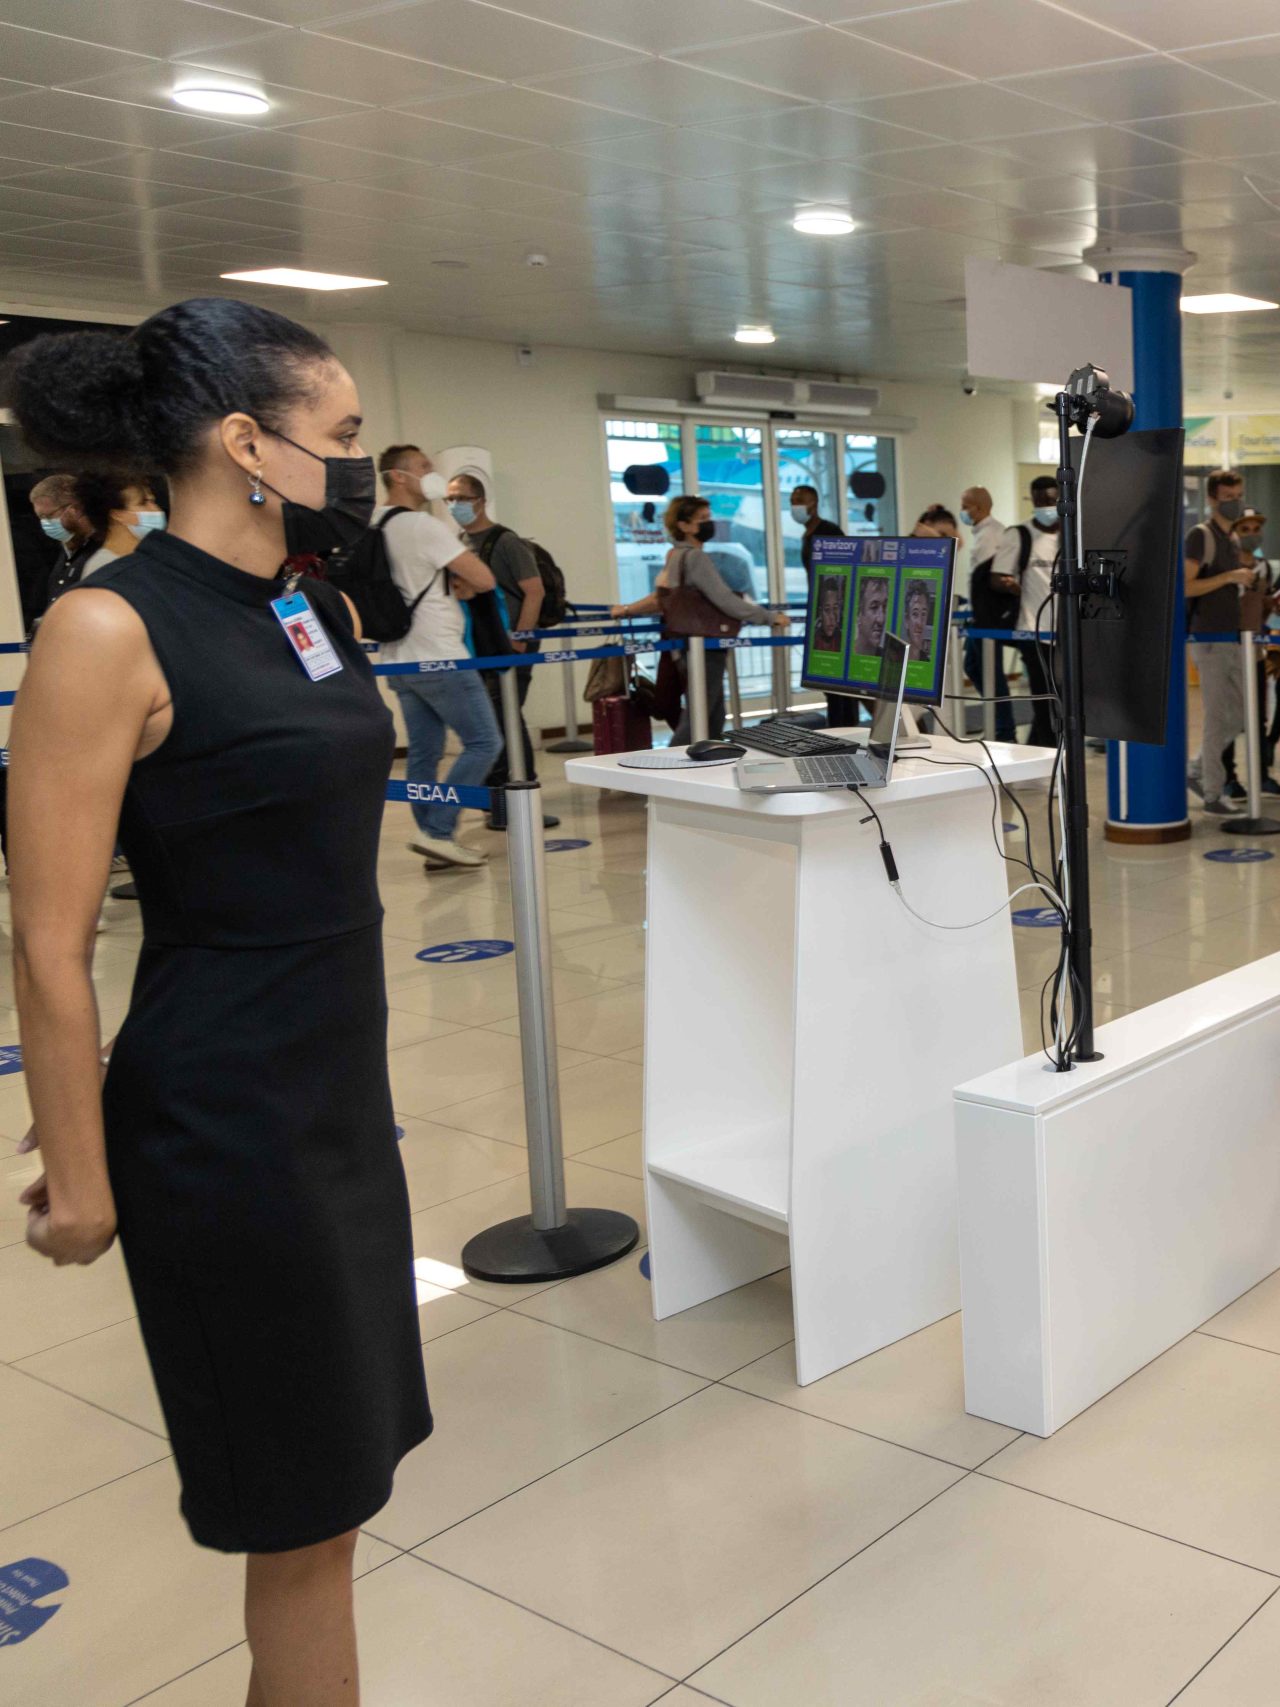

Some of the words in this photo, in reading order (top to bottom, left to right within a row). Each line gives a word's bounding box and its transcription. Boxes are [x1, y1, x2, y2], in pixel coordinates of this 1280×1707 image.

[823, 539, 858, 552] travizory
[624, 642, 655, 655] SCAA
[719, 638, 752, 649] SCAA
[544, 651, 578, 663] SCAA
[419, 660, 458, 673] SCAA
[406, 783, 461, 804] SCAA
